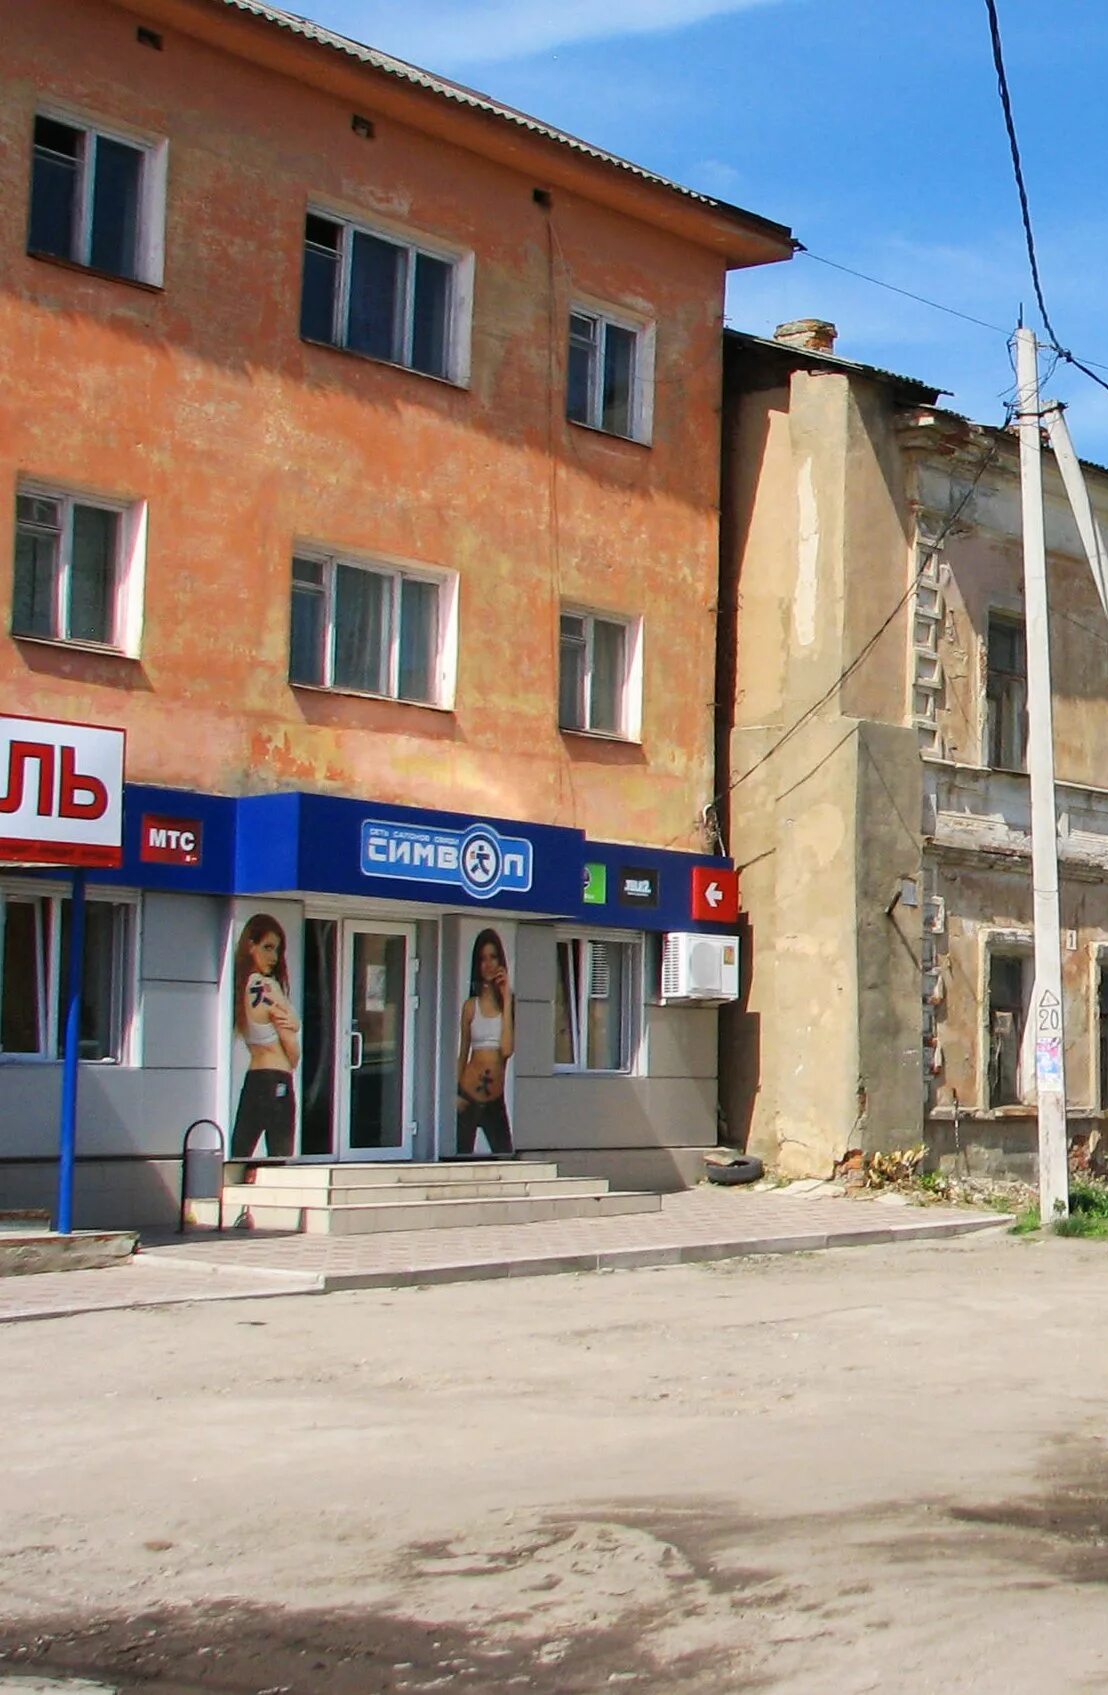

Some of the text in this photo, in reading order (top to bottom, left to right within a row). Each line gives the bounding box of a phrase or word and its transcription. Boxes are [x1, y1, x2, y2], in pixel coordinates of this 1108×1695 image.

[0, 740, 108, 820] ЛЬ
[149, 828, 195, 851] МТС
[1039, 1008, 1059, 1030] 20
